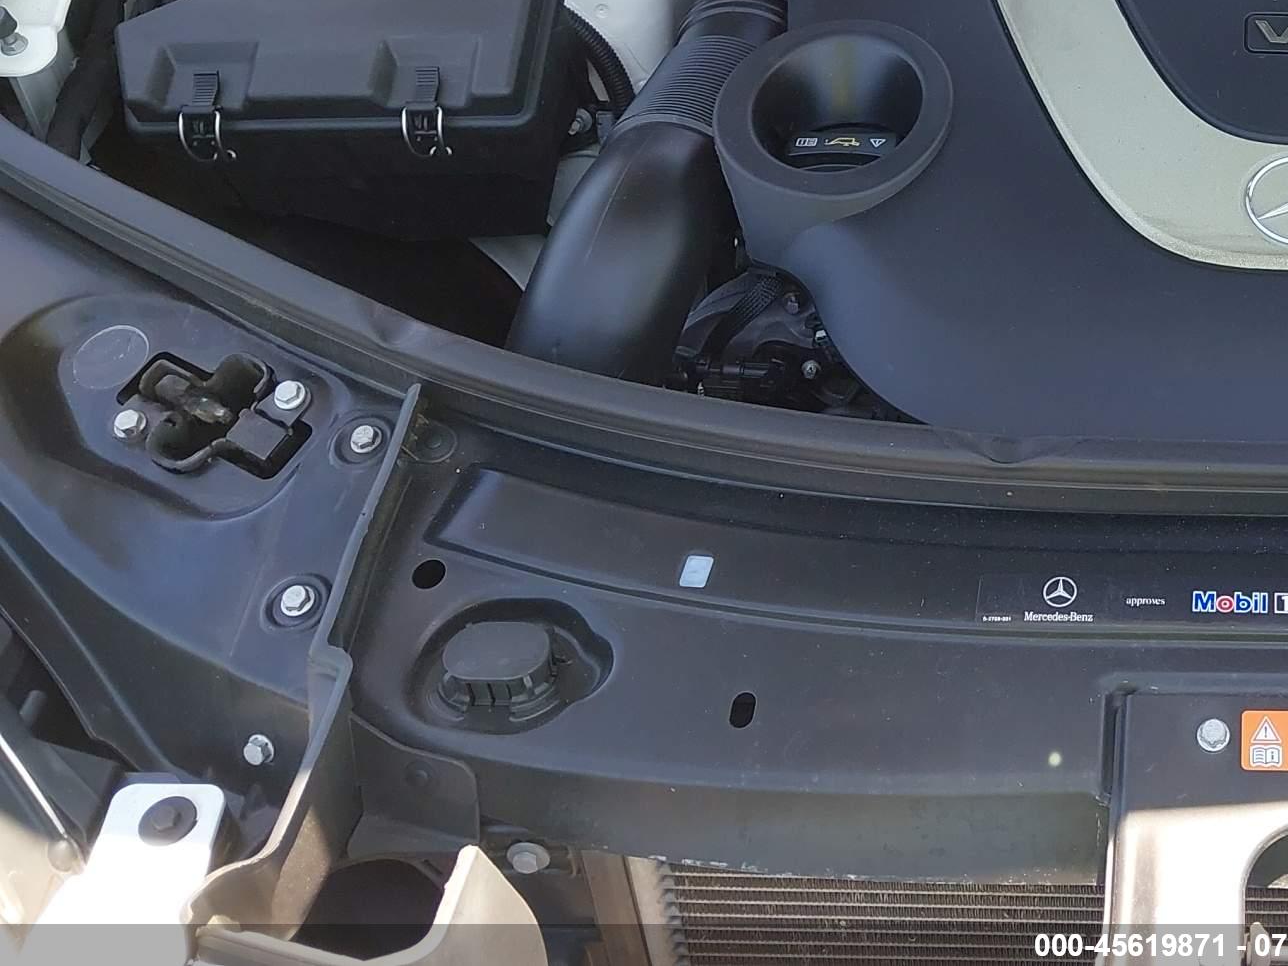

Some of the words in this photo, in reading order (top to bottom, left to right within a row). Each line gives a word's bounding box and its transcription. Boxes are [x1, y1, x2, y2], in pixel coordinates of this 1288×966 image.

[1126, 596, 1166, 607] approves
[1192, 590, 1269, 614] Mobil
[1023, 611, 1094, 622] Mercedes-Benz
